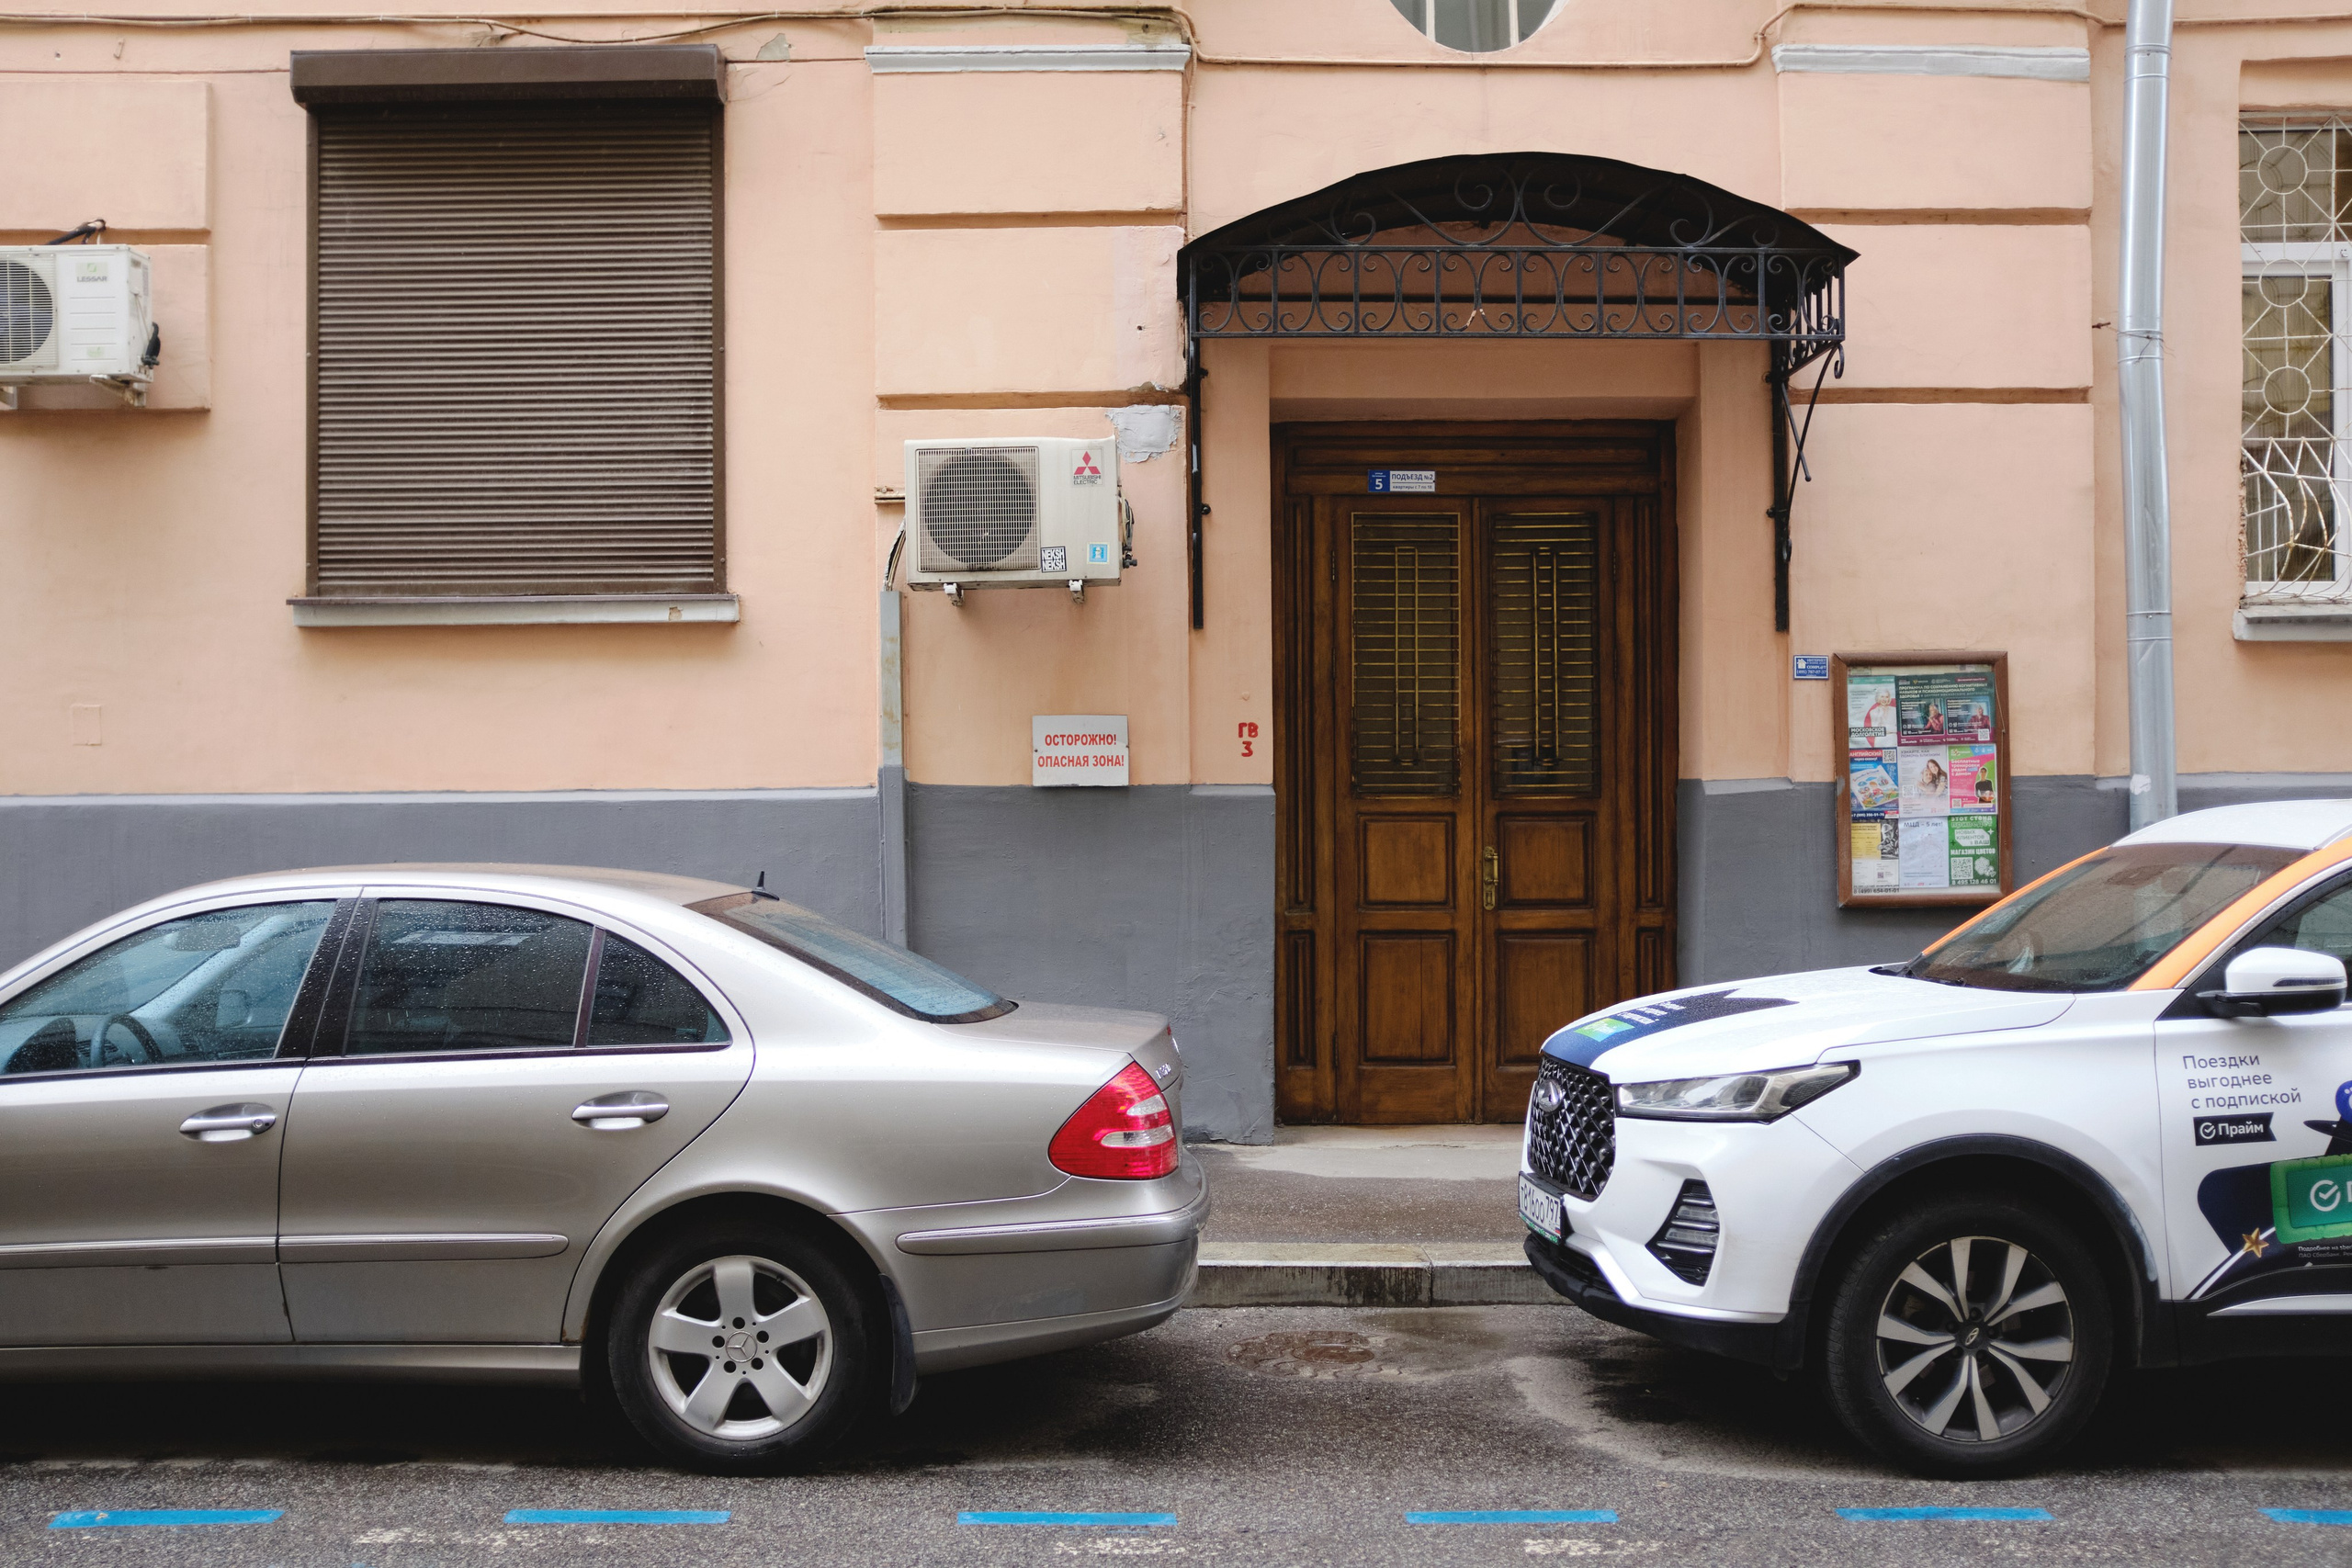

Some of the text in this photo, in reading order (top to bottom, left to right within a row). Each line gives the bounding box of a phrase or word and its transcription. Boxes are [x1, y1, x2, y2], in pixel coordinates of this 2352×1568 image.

[1375, 479, 1383, 490] 5
[1042, 548, 1065, 559] NEKSH
[1043, 559, 1065, 570] NEKSH
[1238, 722, 1259, 738] ГВ
[1045, 734, 1116, 746] ОСТОРОЖНО!
[1241, 740, 1253, 757] 3
[1037, 755, 1125, 767] ОПАСНАЯ ЗОНА!
[2182, 1054, 2260, 1069] Поездки
[2188, 1074, 2272, 1089] выгоднее
[2191, 1089, 2301, 1110] с подпиской
[2218, 1121, 2264, 1137] Прайм
[1545, 1195, 1559, 1223] 797
